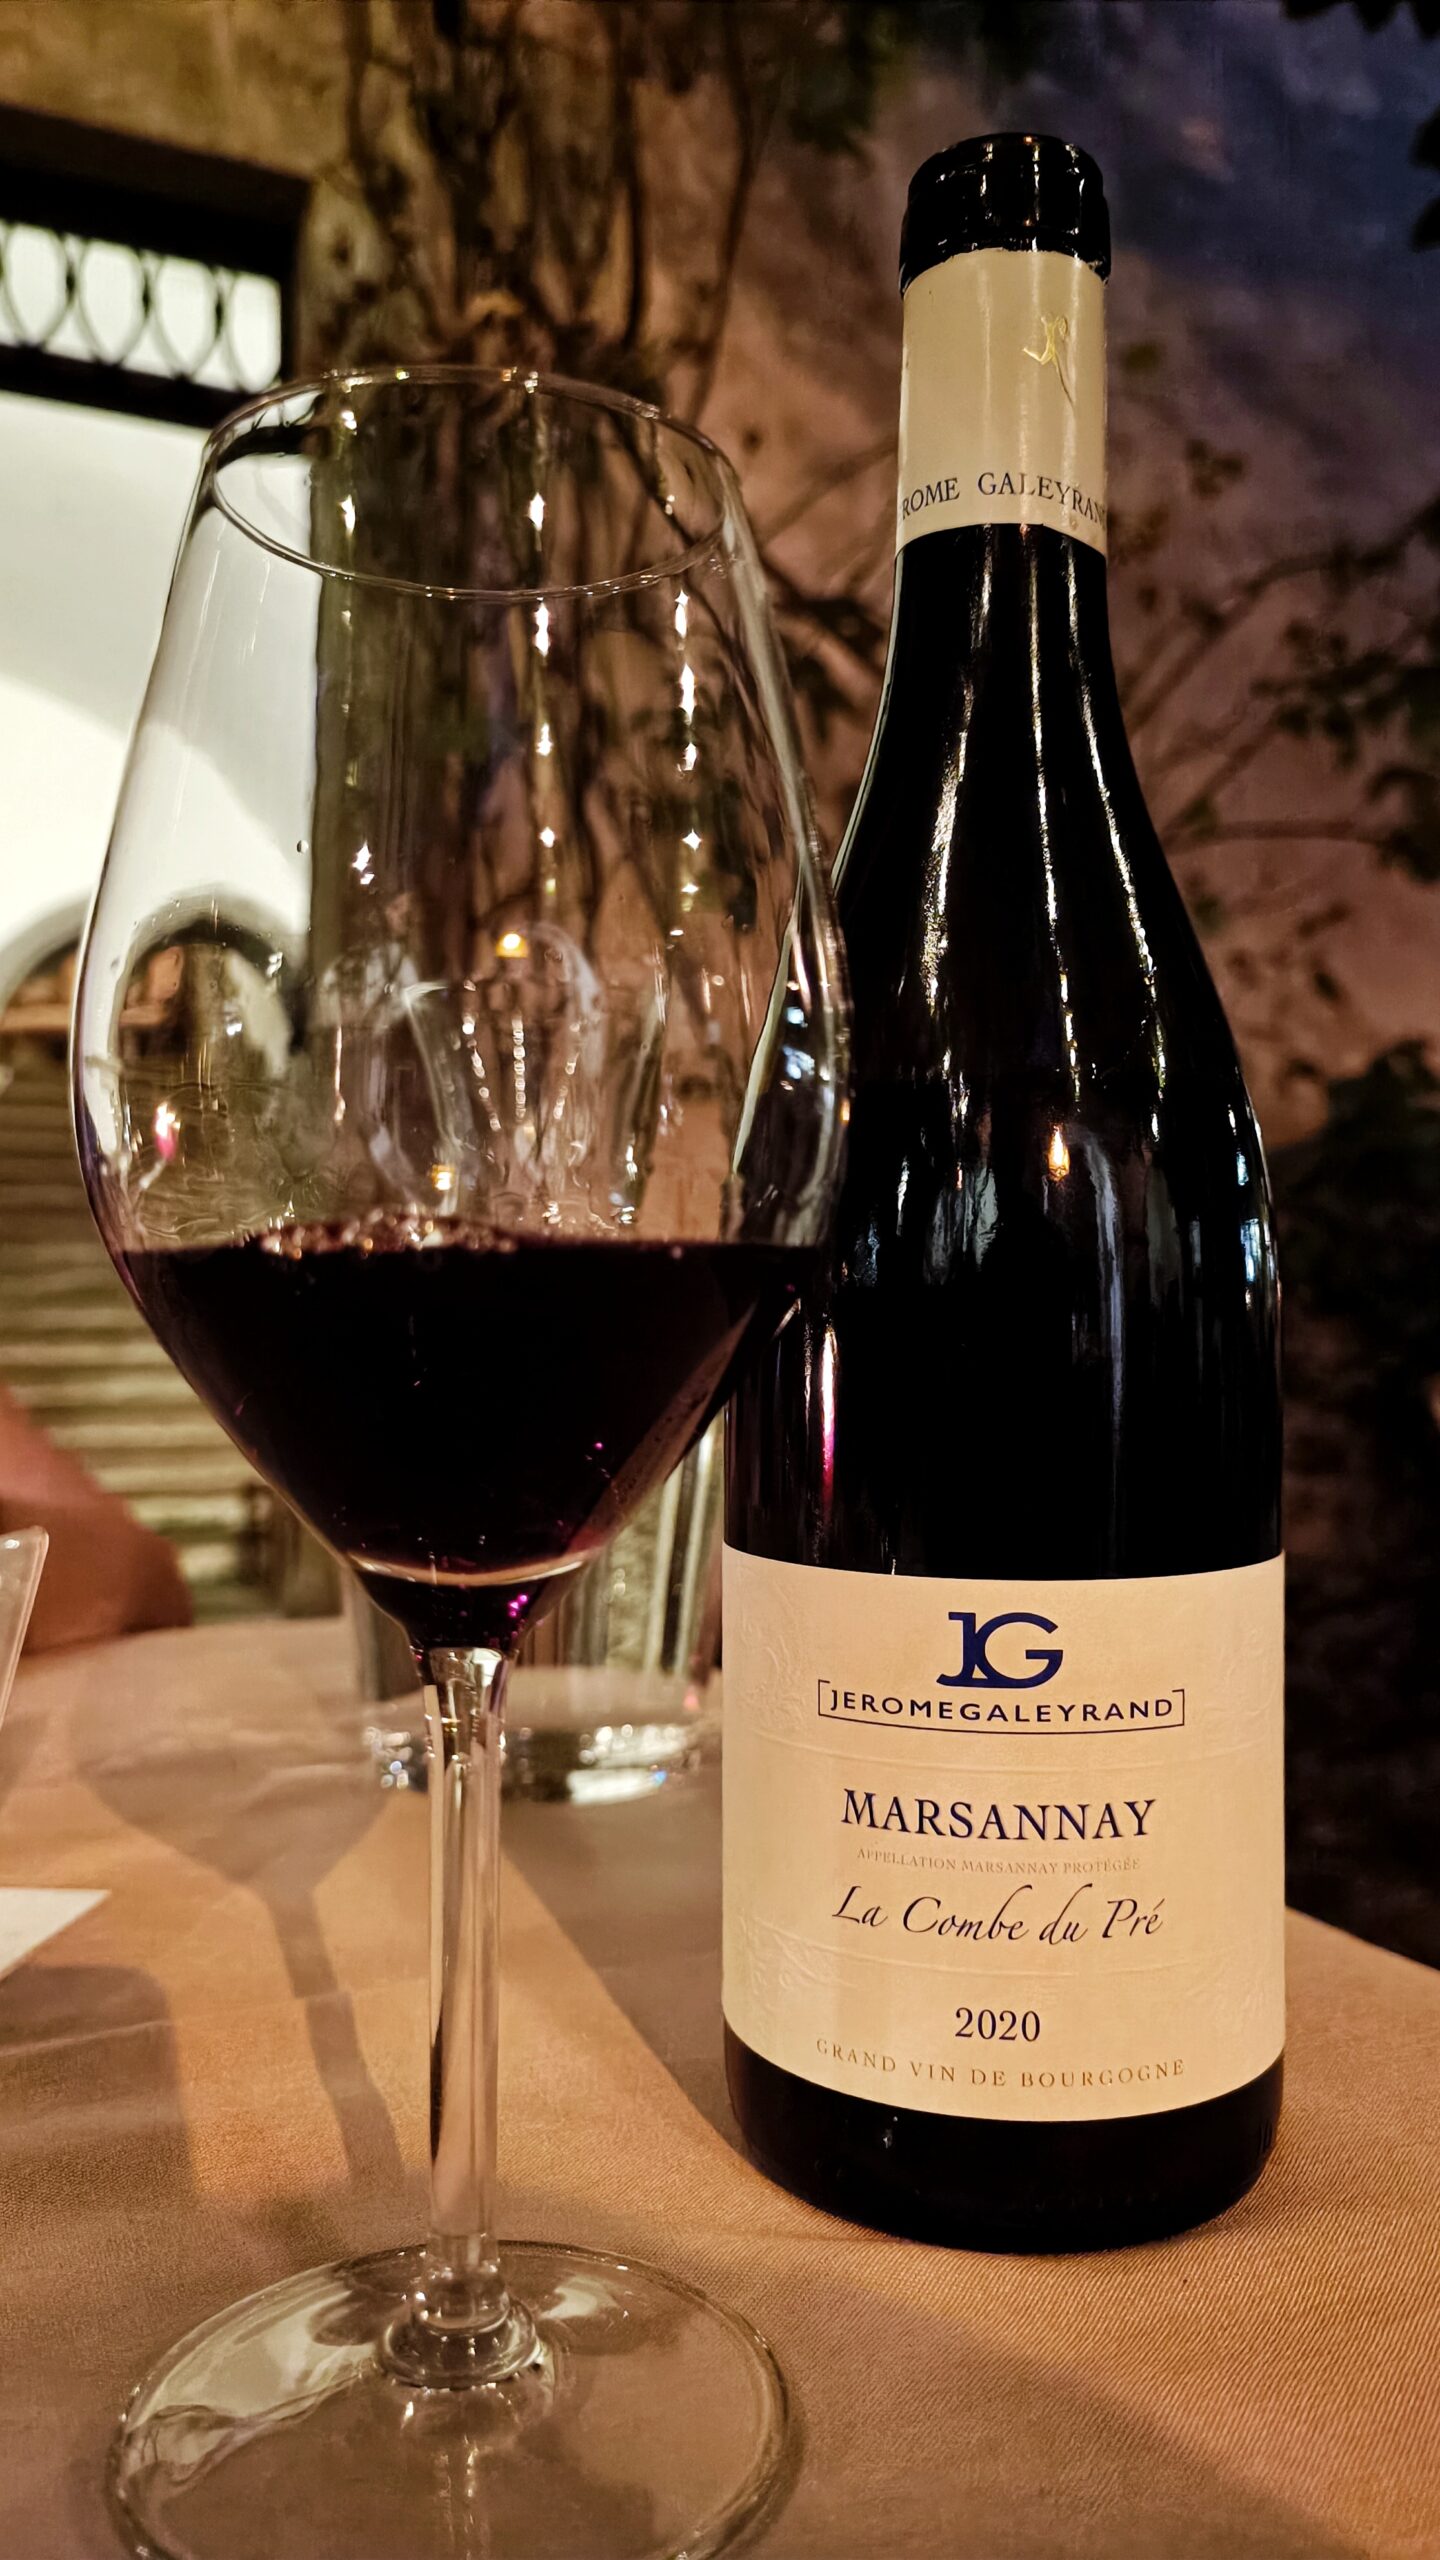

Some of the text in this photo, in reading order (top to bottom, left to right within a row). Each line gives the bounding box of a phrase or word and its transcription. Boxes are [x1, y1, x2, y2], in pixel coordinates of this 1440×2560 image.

[936, 1612, 1064, 1689] JG
[829, 1689, 1174, 1723] JEROMEGALEYRAND
[841, 1787, 1156, 1841] MARSANNAY
[856, 1847, 956, 1871] APPELLATION
[961, 1858, 1058, 1875] MARSANNAY
[832, 1882, 1165, 1946] La Combe du Pré
[955, 2006, 1041, 2043] 2020
[816, 2037, 1185, 2088] GRAND VIN DE BOURGOGNE
